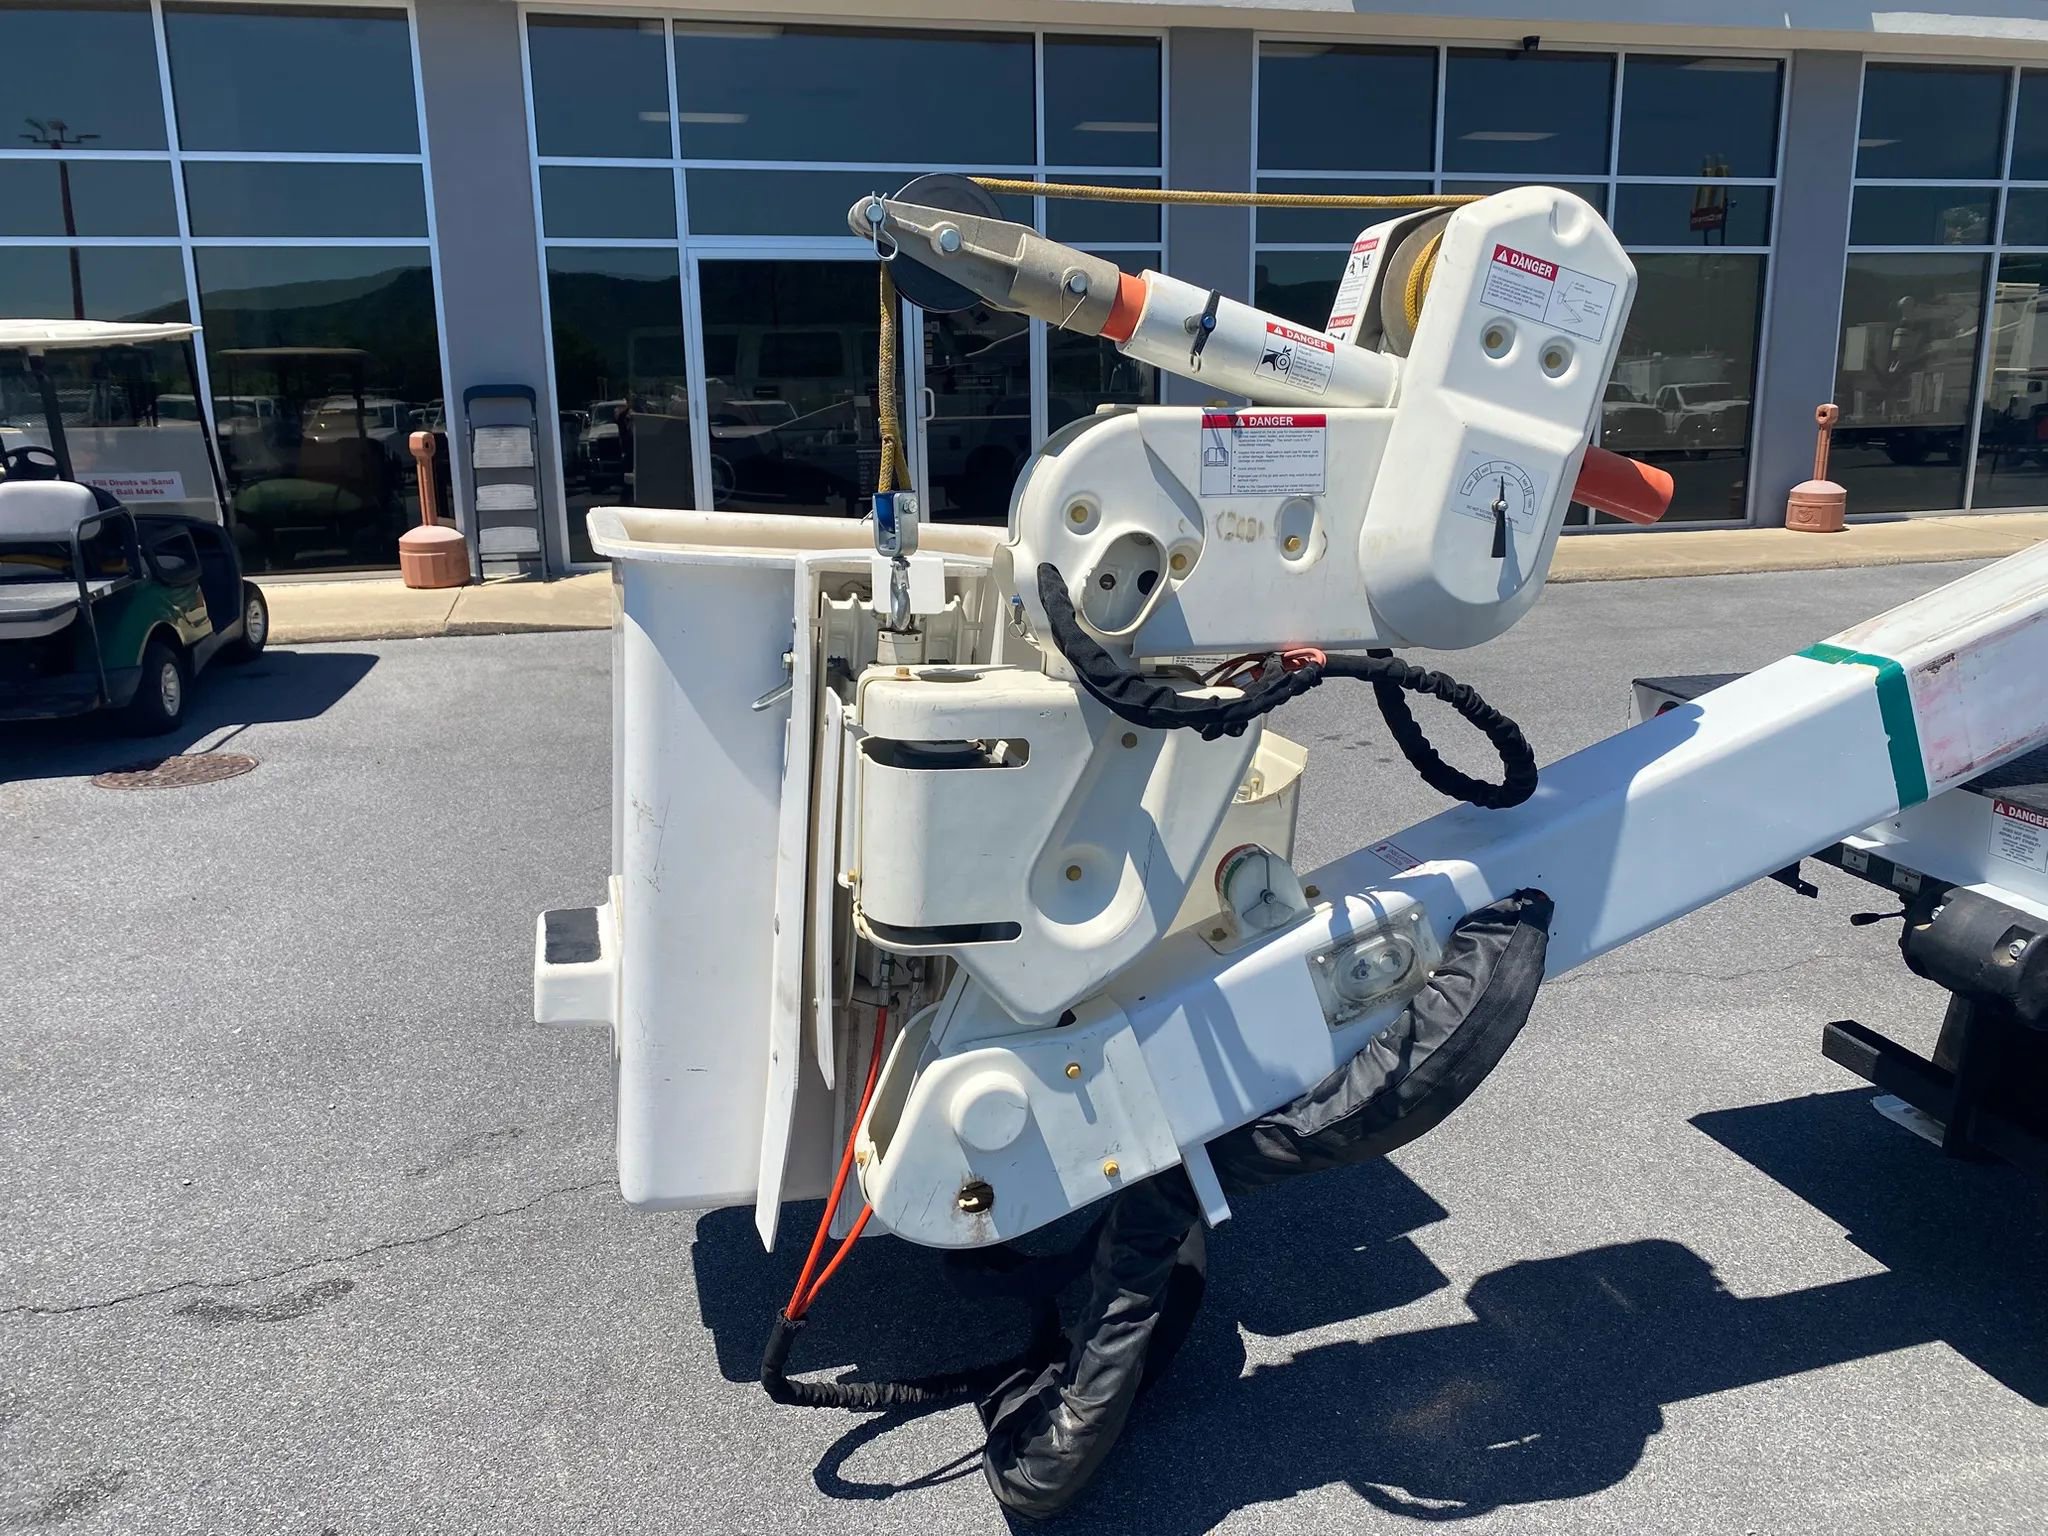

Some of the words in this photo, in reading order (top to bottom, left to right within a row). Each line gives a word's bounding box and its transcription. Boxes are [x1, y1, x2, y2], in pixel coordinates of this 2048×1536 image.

[1359, 242, 1378, 252] DANGER
[1510, 253, 1553, 277] DANGER
[1333, 318, 1354, 328] DANGER
[1286, 329, 1328, 350] DANGER
[1249, 416, 1294, 426] DANGER
[2009, 806, 2048, 827] DANGER
